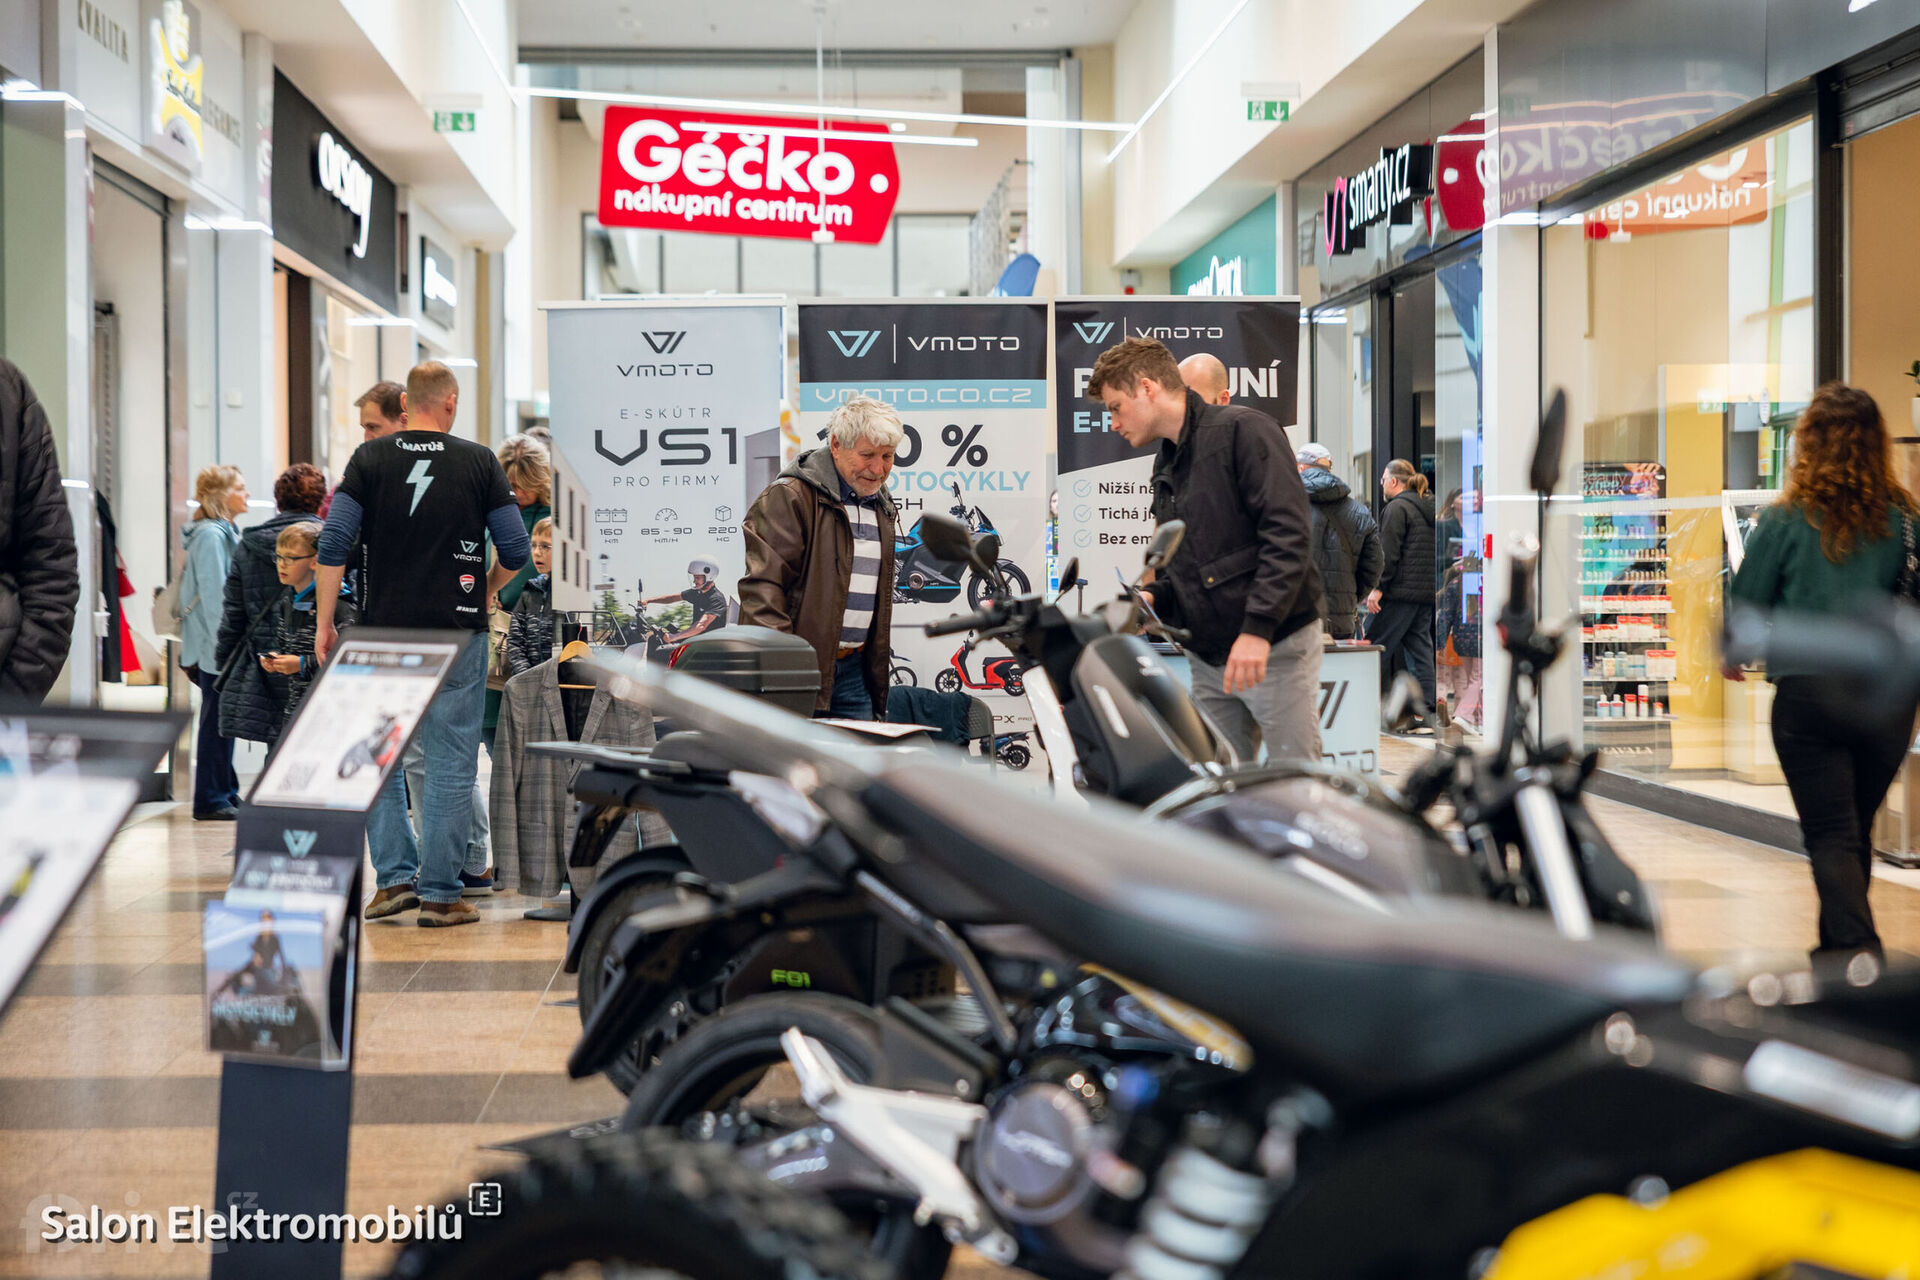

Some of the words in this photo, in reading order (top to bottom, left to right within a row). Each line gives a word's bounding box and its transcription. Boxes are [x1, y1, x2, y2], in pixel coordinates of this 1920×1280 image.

[617, 119, 855, 195] Géčko
[1349, 143, 1411, 230] smarty.cz
[614, 183, 733, 222] nákupní
[735, 196, 853, 226] centrum
[1135, 327, 1223, 339] VMOTO
[907, 336, 1020, 351] VMOTO
[616, 364, 713, 377] VMOTO
[594, 427, 737, 466] VS1
[612, 476, 650, 487] PRO
[662, 474, 720, 486] FIRMY
[1099, 481, 1136, 494] Nižší
[1099, 507, 1138, 519] Tichá
[600, 528, 623, 536] 160
[708, 526, 737, 534] 220
[1099, 533, 1126, 544] Bez
[453, 553, 482, 562] VMOTO
[992, 715, 1015, 724] PX
